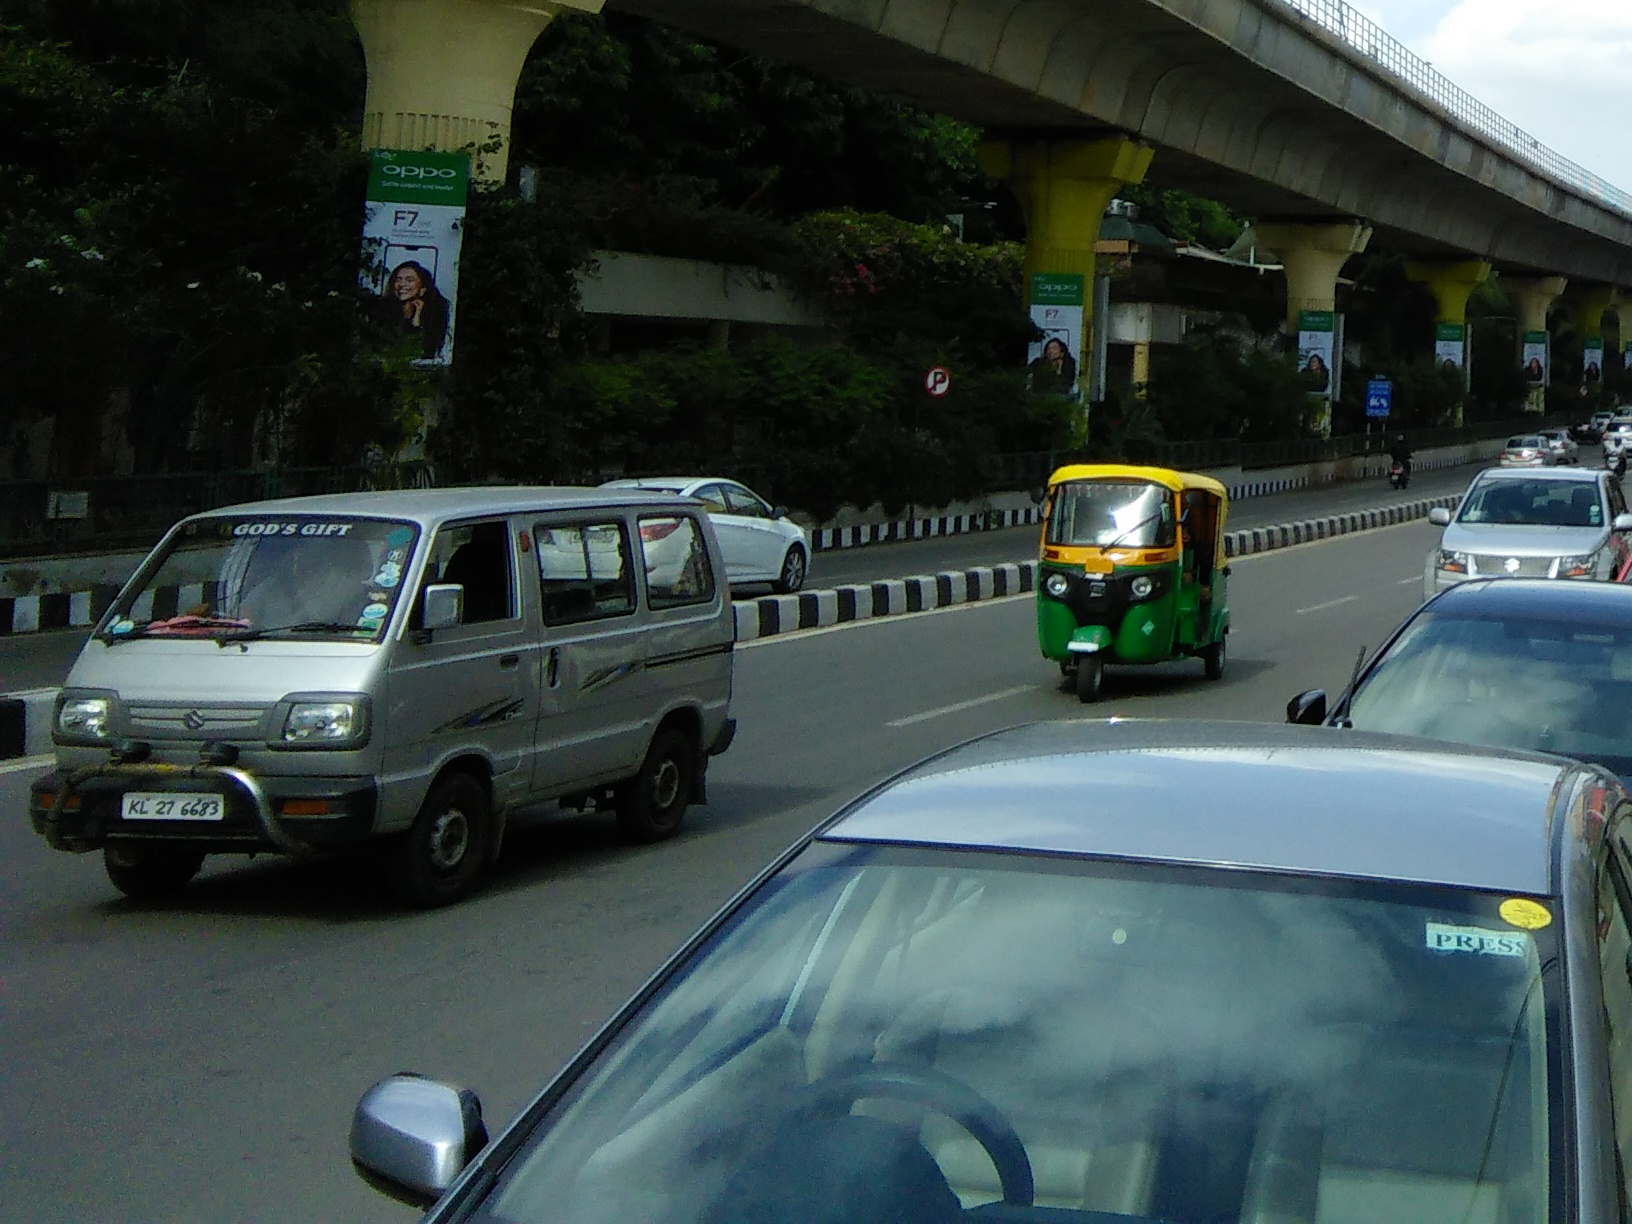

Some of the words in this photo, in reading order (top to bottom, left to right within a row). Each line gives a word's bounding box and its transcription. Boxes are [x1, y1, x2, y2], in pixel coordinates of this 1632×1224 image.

[393, 209, 420, 227] F7
[233, 523, 299, 537] GOD'S
[301, 523, 353, 537] GIFT
[127, 798, 149, 815] KL
[155, 799, 176, 816] 27
[180, 800, 219, 817] 6683
[1436, 932, 1526, 955] PRESS
